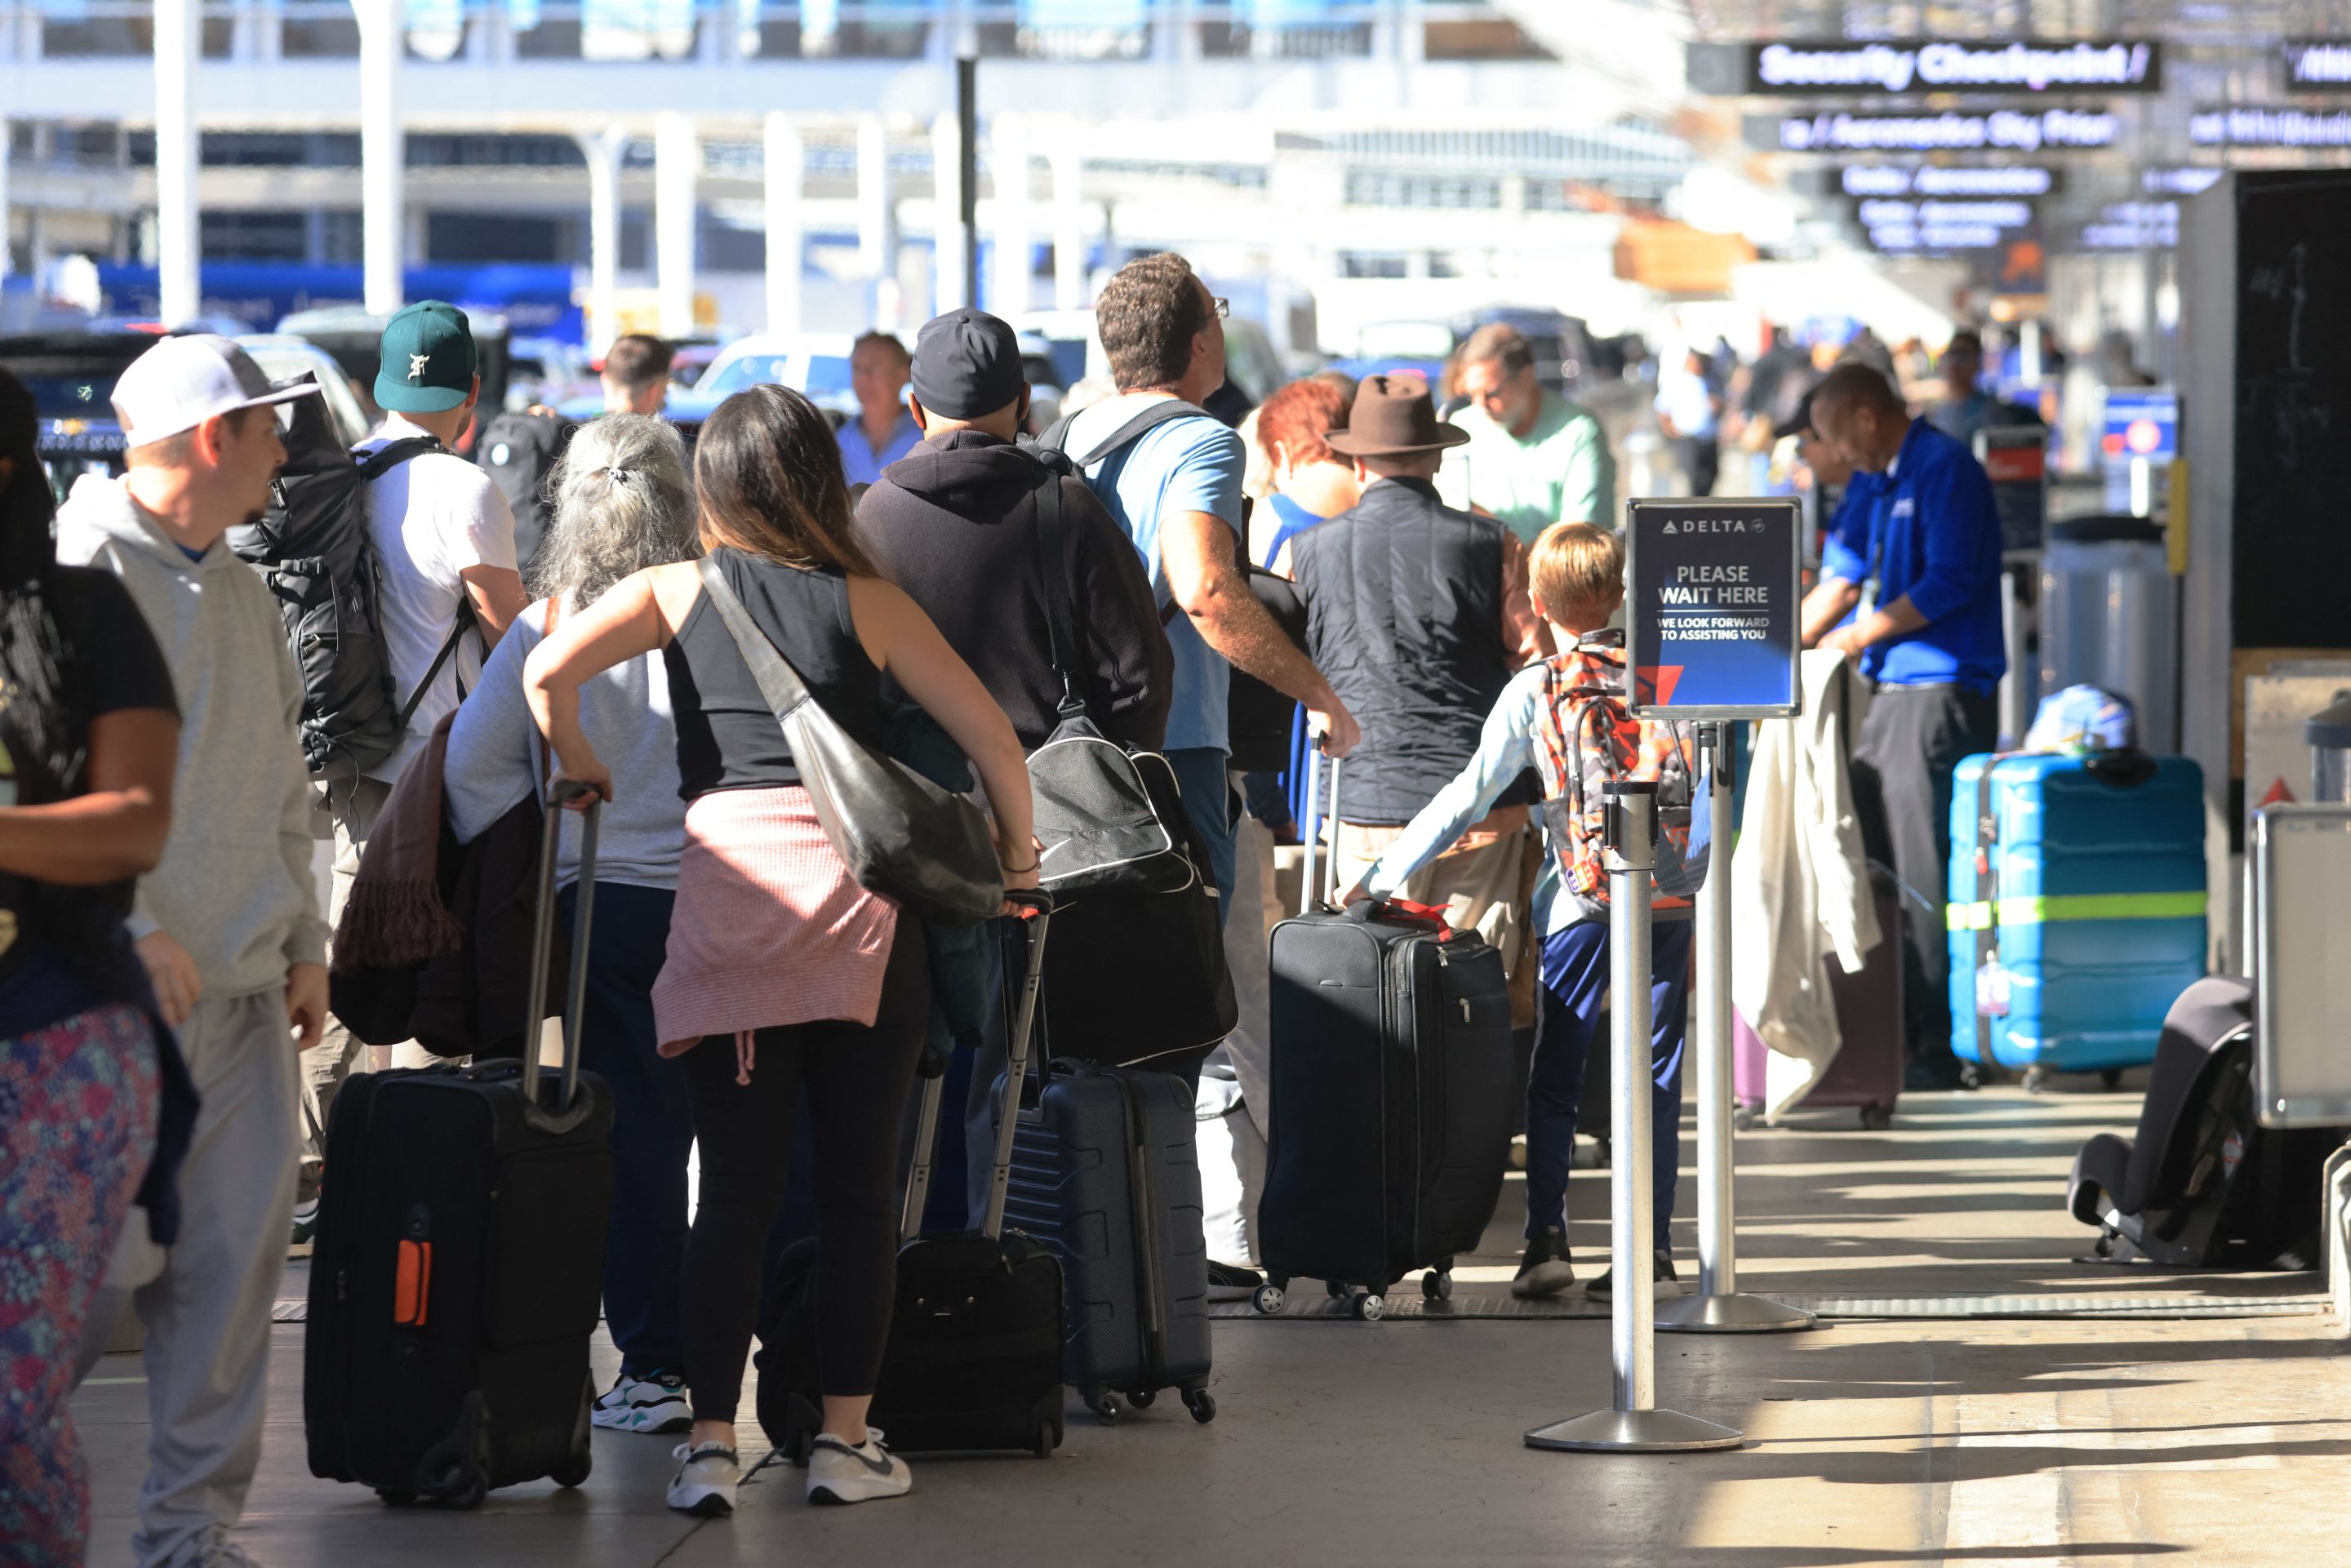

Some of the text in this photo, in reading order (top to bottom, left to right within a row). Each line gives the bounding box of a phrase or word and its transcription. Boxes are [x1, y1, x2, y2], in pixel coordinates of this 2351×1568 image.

[1759, 44, 1915, 91] Security
[1918, 43, 2129, 91] Checkpoint
[1682, 520, 1746, 532] DELTA
[1677, 566, 1749, 583] PLEASE
[1657, 586, 1769, 604] WAIT HERE
[1657, 617, 1770, 628] WE LOOK FORWARD
[1660, 629, 1767, 640] TO ASSISTING YOU
